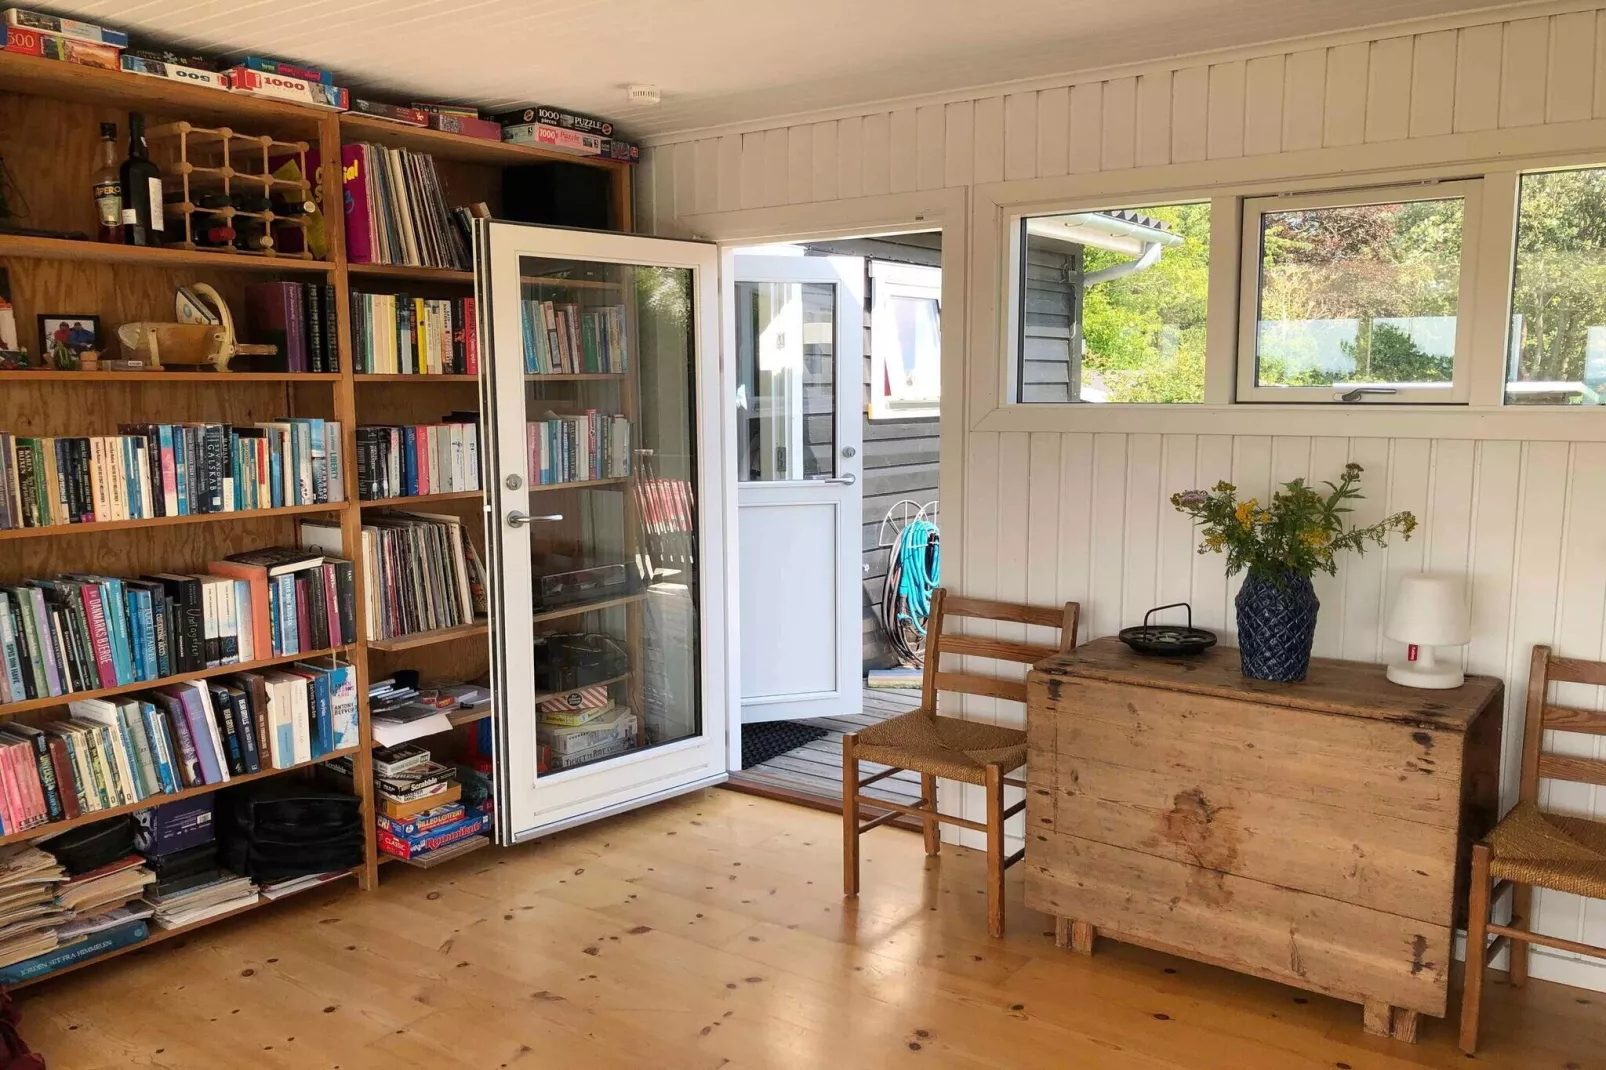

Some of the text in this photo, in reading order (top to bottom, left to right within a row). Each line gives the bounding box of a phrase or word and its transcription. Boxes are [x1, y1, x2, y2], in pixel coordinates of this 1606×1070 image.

[8, 32, 34, 48] 500
[175, 70, 211, 82] 500
[264, 76, 306, 92] 1000
[539, 108, 560, 120] 1000
[574, 116, 602, 129] PUZZLE
[540, 128, 580, 142] 1000 Puzzle
[18, 450, 26, 474] BLIXEN
[24, 450, 32, 472] KAREN
[208, 444, 216, 491] GALSKAB
[330, 452, 338, 480] LIBERTY
[144, 608, 153, 631] FUGLE
[89, 598, 112, 664] DANMARKS BJERGE
[186, 608, 202, 657] Undtagelsen
[147, 635, 155, 662] FARVER
[6, 644, 15, 658] SPIS
[12, 669, 20, 684] HAVE
[238, 698, 247, 710] BEAR
[223, 708, 235, 734] BEAR GRYLLS
[240, 710, 249, 725] GRYLLS
[566, 754, 588, 766] TICKET
[592, 748, 607, 757] RIDE
[411, 777, 438, 791] Scrabble
[48, 791, 59, 816] HAWKING
[384, 838, 406, 850] CLASSIC
[20, 940, 112, 977] JORDEN SET FRA HIMMELEN
